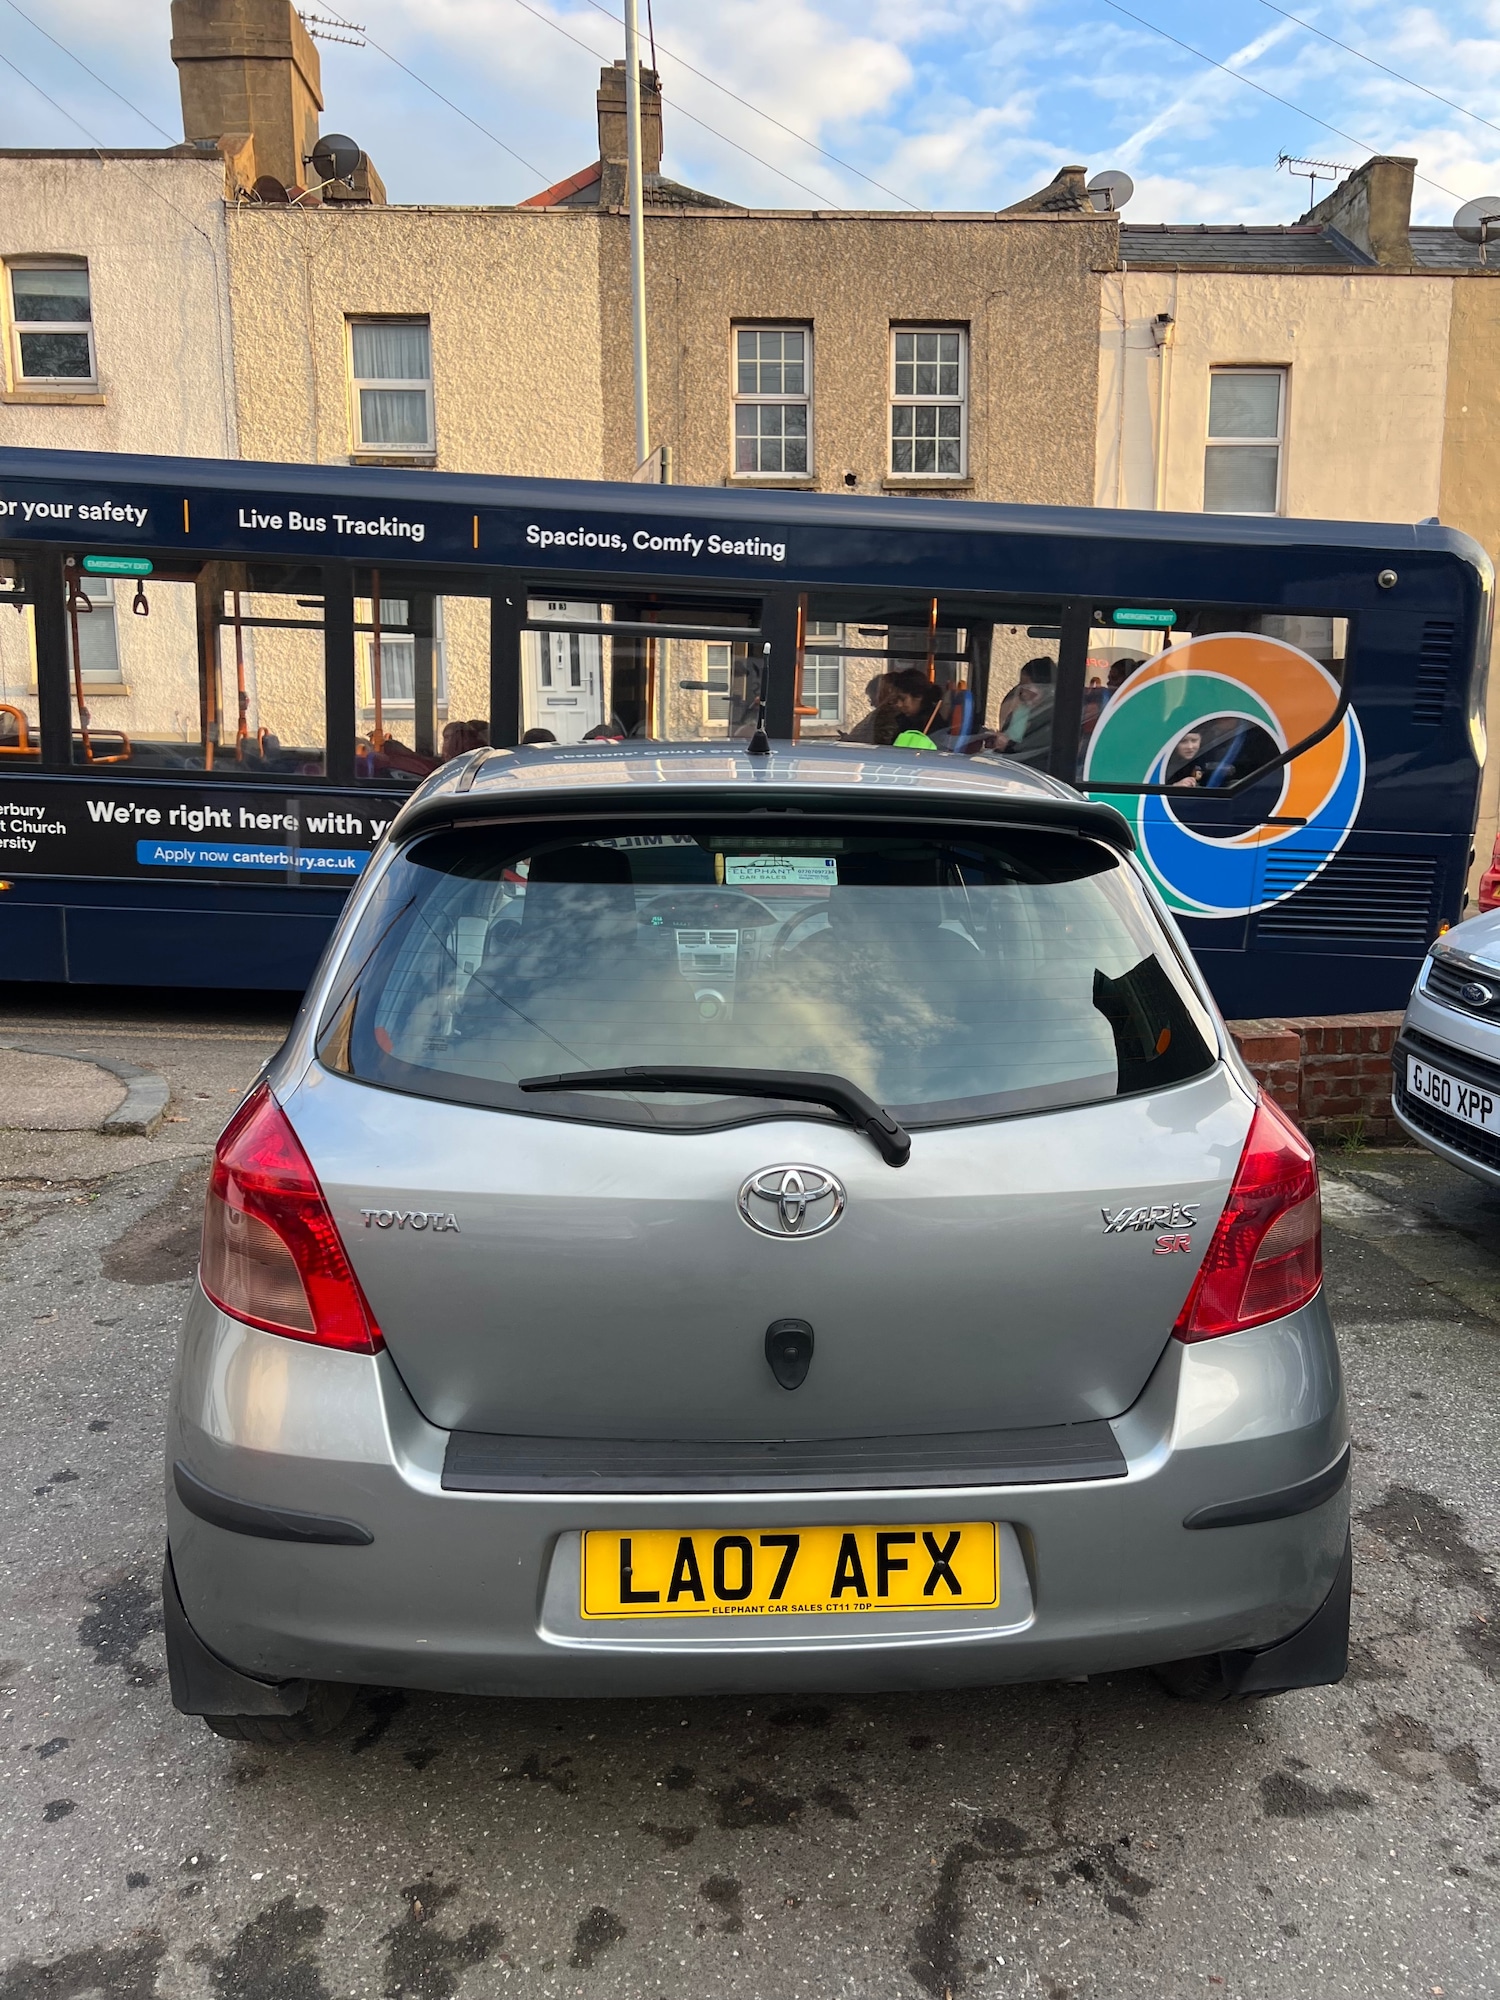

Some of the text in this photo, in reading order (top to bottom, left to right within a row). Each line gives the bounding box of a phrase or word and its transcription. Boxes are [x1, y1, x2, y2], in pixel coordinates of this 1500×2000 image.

[21, 501, 74, 521] your
[78, 501, 148, 527] safety
[238, 508, 425, 542] Live Bus Tracking
[526, 524, 786, 562] Spacious, Comfy Seating
[87, 560, 149, 570] EMERGENCY EXIT
[1116, 613, 1174, 622] EMERGENCY EXIT
[10, 820, 66, 835] Church
[87, 801, 161, 825] We're
[169, 804, 232, 832] right
[239, 807, 300, 832] here
[306, 812, 362, 835] with
[154, 847, 356, 870] Apply now canterbury.ac.uk
[1413, 1064, 1451, 1108] GJ60
[1457, 1085, 1493, 1124] XPP
[360, 1209, 461, 1233] TOYOTA
[1153, 1233, 1191, 1255] SR
[619, 1530, 963, 1604] LA07 AFX
[712, 1605, 765, 1614] ELEPHANT
[791, 1604, 823, 1612] SALES
[826, 1603, 850, 1611] CT11
[853, 1603, 872, 1611] 7DP
